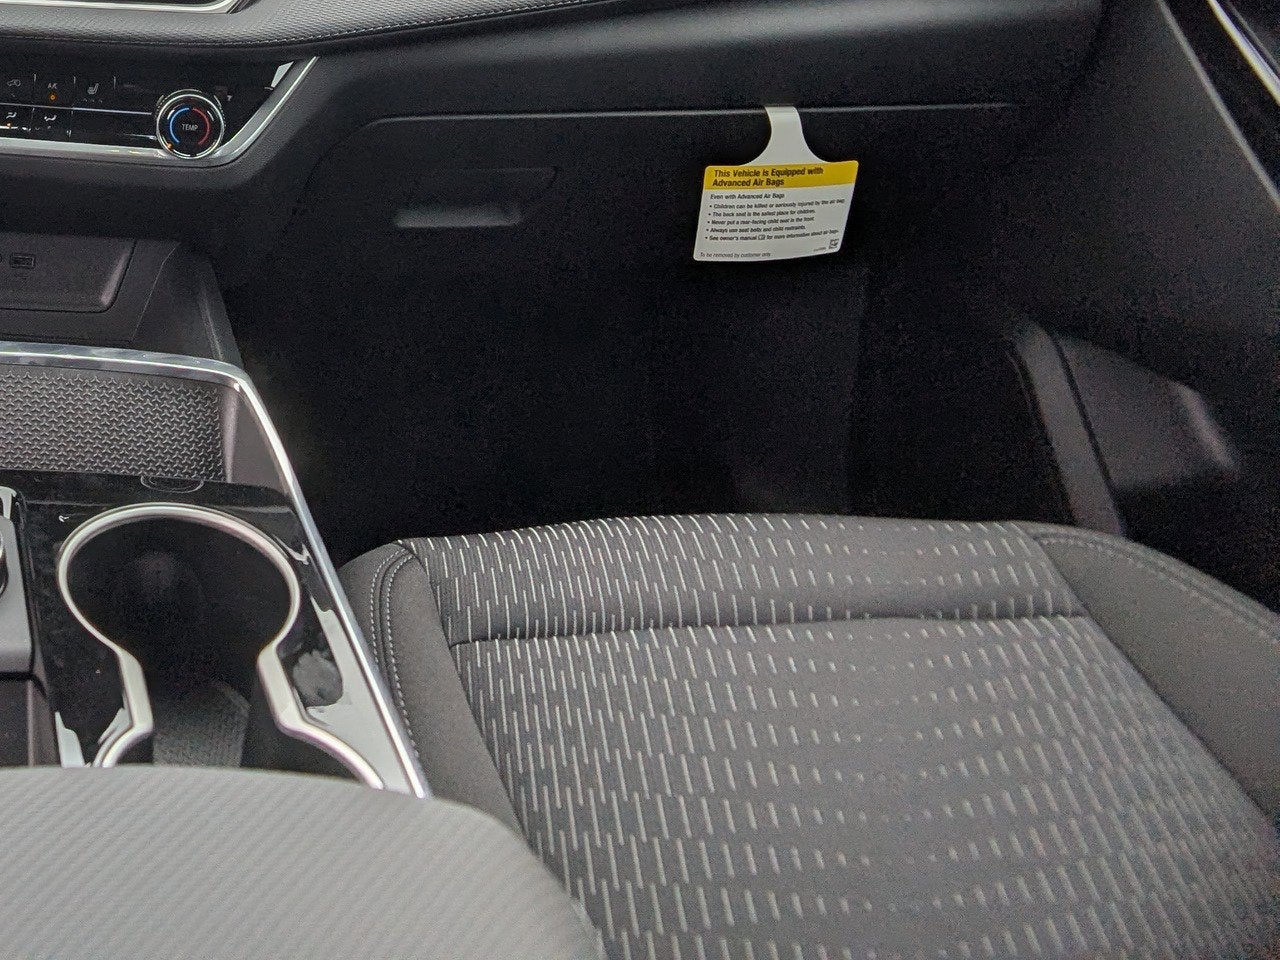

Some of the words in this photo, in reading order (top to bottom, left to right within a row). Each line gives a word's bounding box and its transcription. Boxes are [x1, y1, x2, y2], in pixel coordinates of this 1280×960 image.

[181, 123, 199, 132] TEMP
[714, 169, 731, 178] This
[733, 168, 761, 178] Vehicle
[771, 167, 806, 178] Equipped
[807, 166, 824, 175] with
[712, 178, 751, 187] Advanced
[753, 178, 764, 186] Air
[766, 177, 785, 188] Bags
